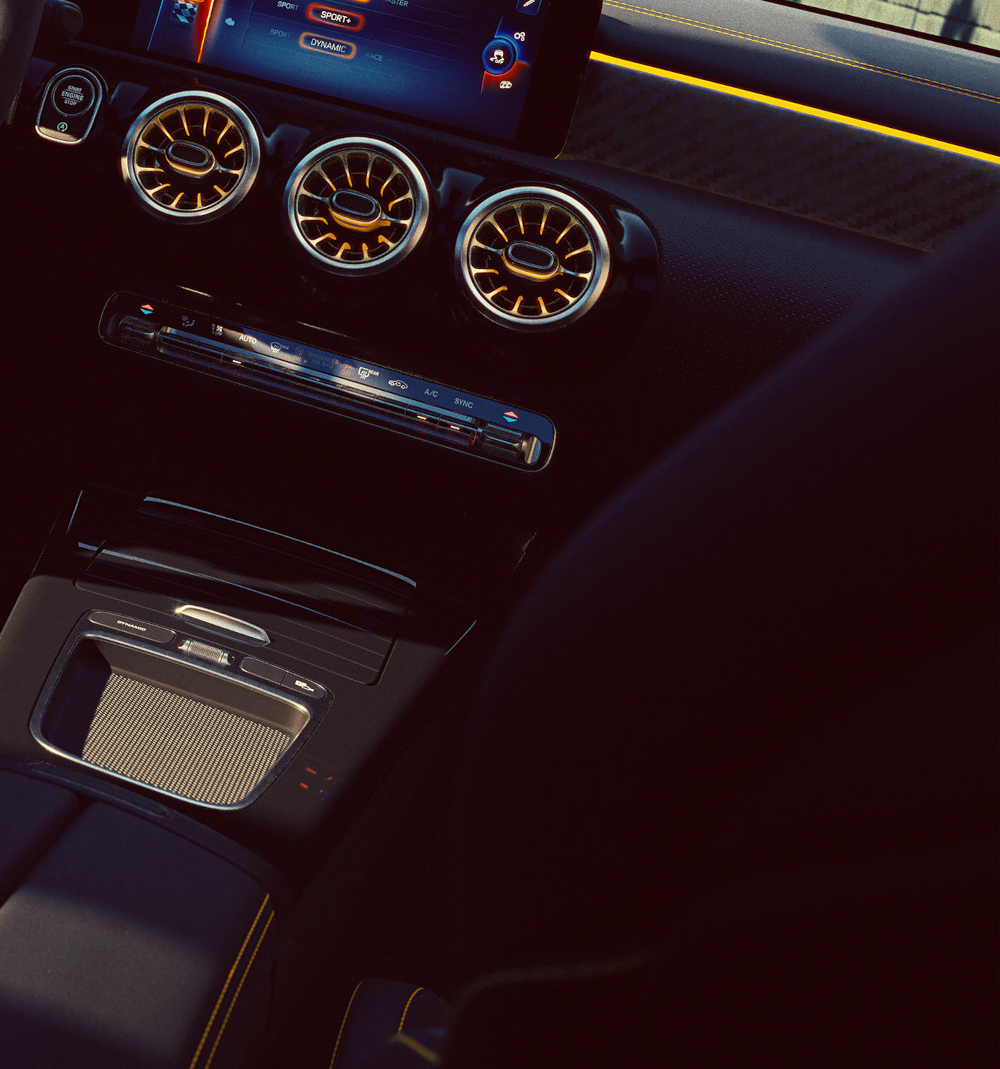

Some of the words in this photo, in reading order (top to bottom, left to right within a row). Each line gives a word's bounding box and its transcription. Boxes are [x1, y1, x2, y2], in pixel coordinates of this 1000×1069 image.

[277, 0, 299, 11] SPORT
[320, 10, 352, 25] SPORT+
[269, 28, 291, 39] SPORT
[310, 38, 347, 53] DYNAMIC
[366, 51, 383, 62] RACE
[61, 90, 84, 101] ENGINE
[238, 334, 257, 345] AUTO
[292, 355, 302, 363] ON
[307, 351, 340, 366] PASSENGER
[340, 368, 352, 377] OFF
[367, 368, 380, 377] REAR
[424, 388, 439, 398] A/C
[454, 397, 474, 409] SYNC
[116, 620, 146, 631] DYNAMIC
